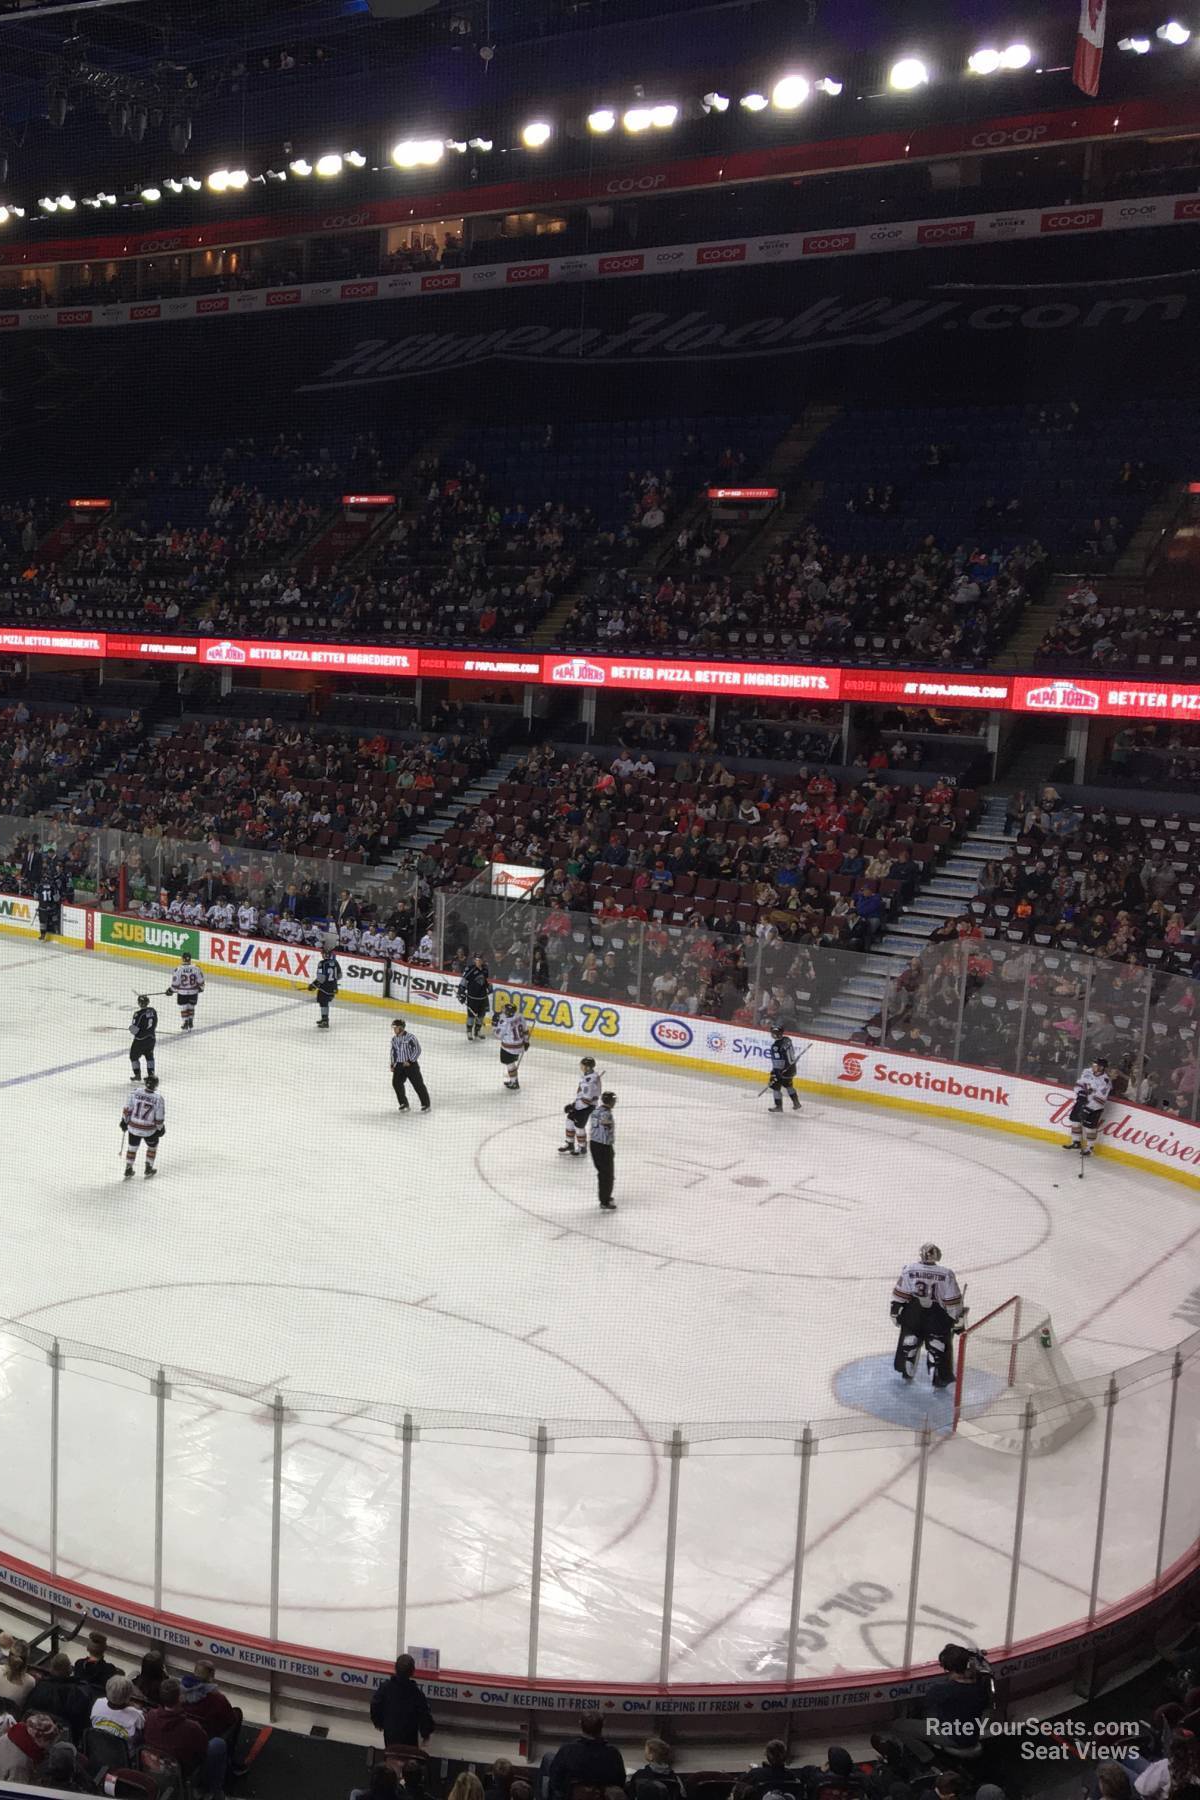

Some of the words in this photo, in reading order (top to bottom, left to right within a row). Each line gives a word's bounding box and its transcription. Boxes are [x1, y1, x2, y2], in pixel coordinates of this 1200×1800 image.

[606, 174, 667, 193] CO-OP
[1048, 213, 1097, 229] CO-OP
[923, 224, 969, 240] CO-OP
[807, 237, 850, 251] CO-OP
[603, 257, 640, 271] CO-OP
[702, 248, 742, 262] CO-OP
[511, 266, 545, 280] CO-OP
[344, 285, 376, 296] CO-OP
[249, 648, 281, 659] BETTER
[311, 652, 344, 663] BETTER
[610, 666, 654, 680] BETTER
[656, 668, 694, 683] PIZZA.
[695, 670, 741, 685] BETTER
[742, 674, 830, 690] INGREDIENTS.
[1028, 689, 1057, 706] PAPA
[1108, 691, 1168, 709] BETTER
[110, 921, 191, 951] SUBWAY
[209, 936, 311, 979] RE/MAX
[492, 988, 575, 1031] PIZZA
[579, 1002, 621, 1038] 73
[731, 1039, 772, 1060] Syne
[873, 1063, 1011, 1107] Scotiabank
[134, 1101, 154, 1121] 17
[1045, 1092, 1200, 1166] Bdweiser
[914, 1280, 938, 1301] 31
[9, 1574, 40, 1596] KEEPING
[48, 1588, 73, 1608] FRESH
[92, 1606, 115, 1622] OPA!
[118, 1614, 151, 1635] KEEPING
[163, 1629, 191, 1647] FRESH
[210, 1642, 236, 1658] OPA!
[238, 1649, 278, 1669] KEEPING
[289, 1661, 320, 1678] FRESH
[340, 1671, 369, 1685] OPA!
[427, 1683, 459, 1699] FRESH
[480, 1691, 509, 1704] OPA!
[513, 1693, 555, 1709] KEEPING
[569, 1698, 601, 1711] FRESH
[622, 1698, 651, 1711] OPA!
[654, 1700, 698, 1713] KEEPING
[710, 1701, 741, 1712] FRESH
[791, 1695, 830, 1709] KEEPING
[840, 1691, 871, 1705] FRESH
